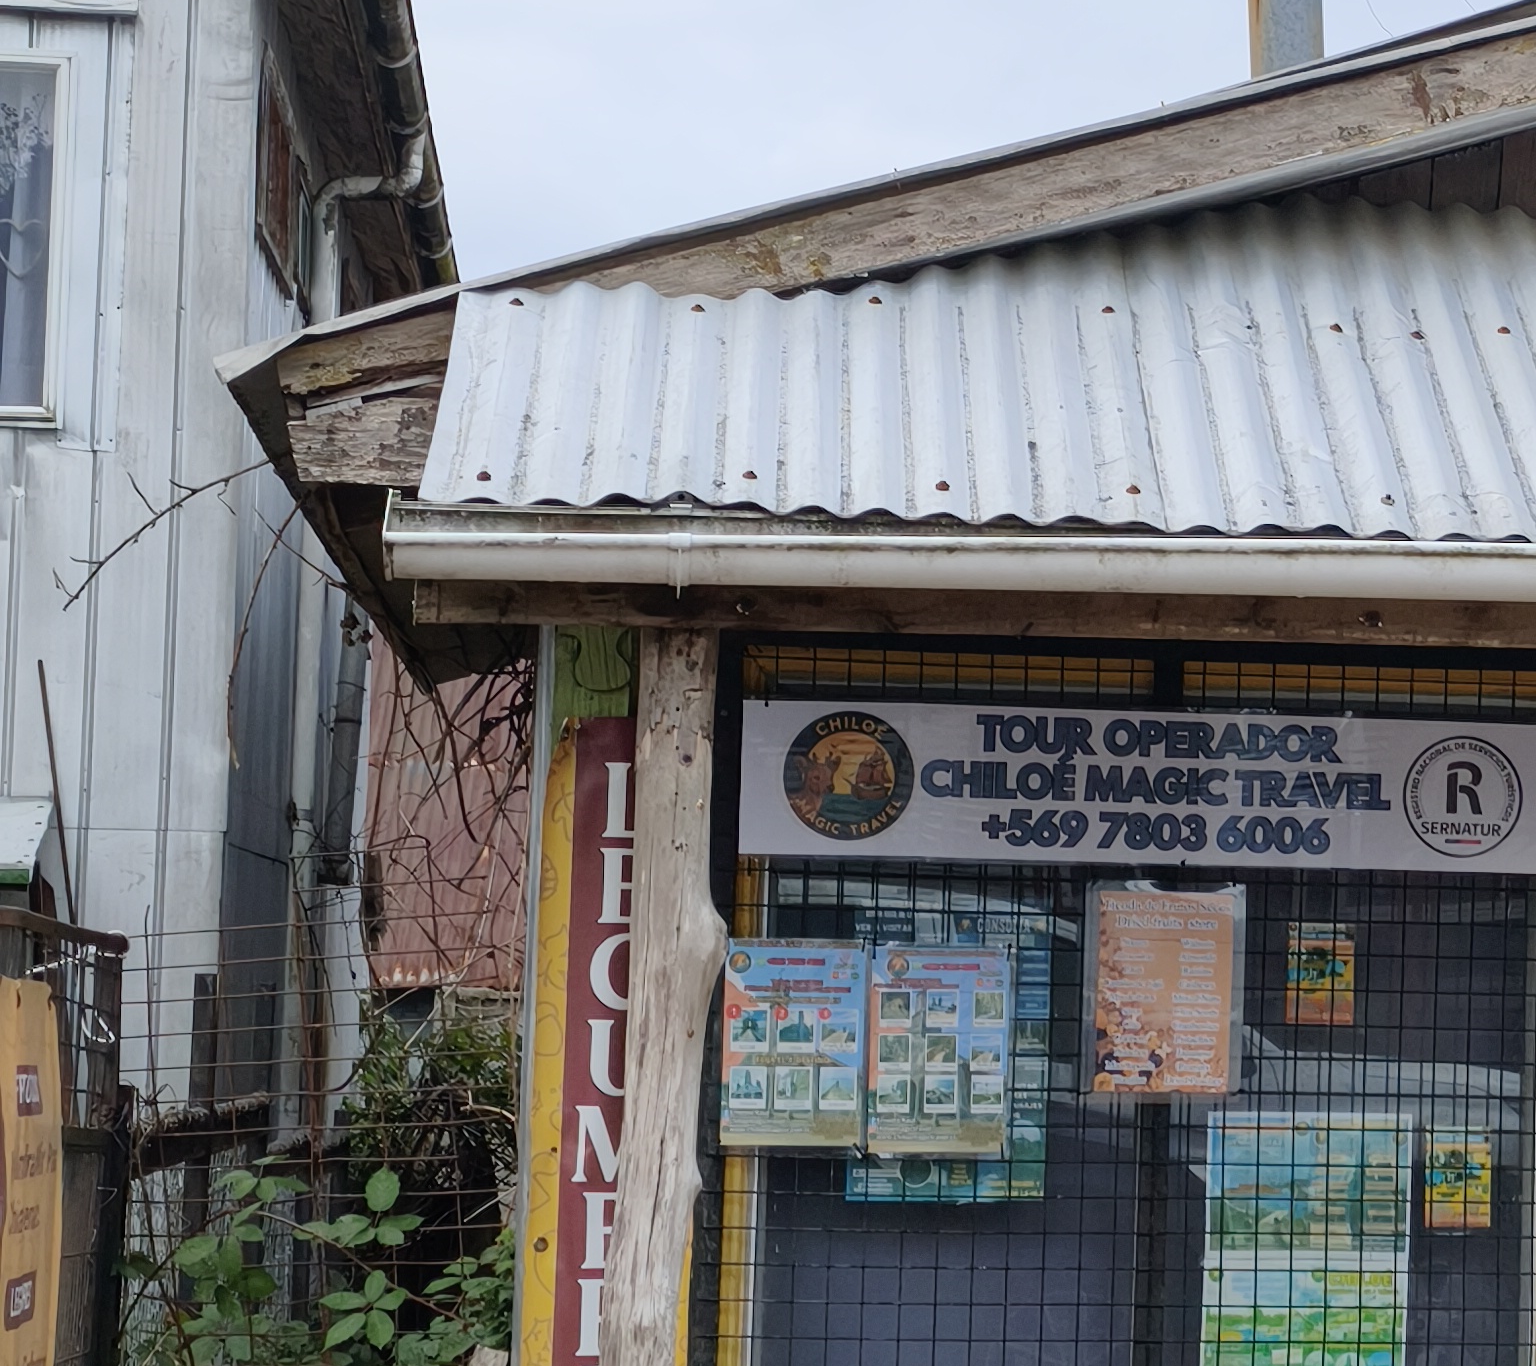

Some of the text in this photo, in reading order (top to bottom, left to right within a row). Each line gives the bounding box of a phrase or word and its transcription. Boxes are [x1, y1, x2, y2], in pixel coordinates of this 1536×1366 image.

[975, 713, 1343, 764] TOUR OPERADOR
[920, 748, 1391, 812] CHILOÉ MAGIC TRAVEL
[849, 800, 903, 835] TRAVEL
[981, 808, 1331, 855] +569 7803 6006
[1420, 821, 1502, 837] SERNATUR
